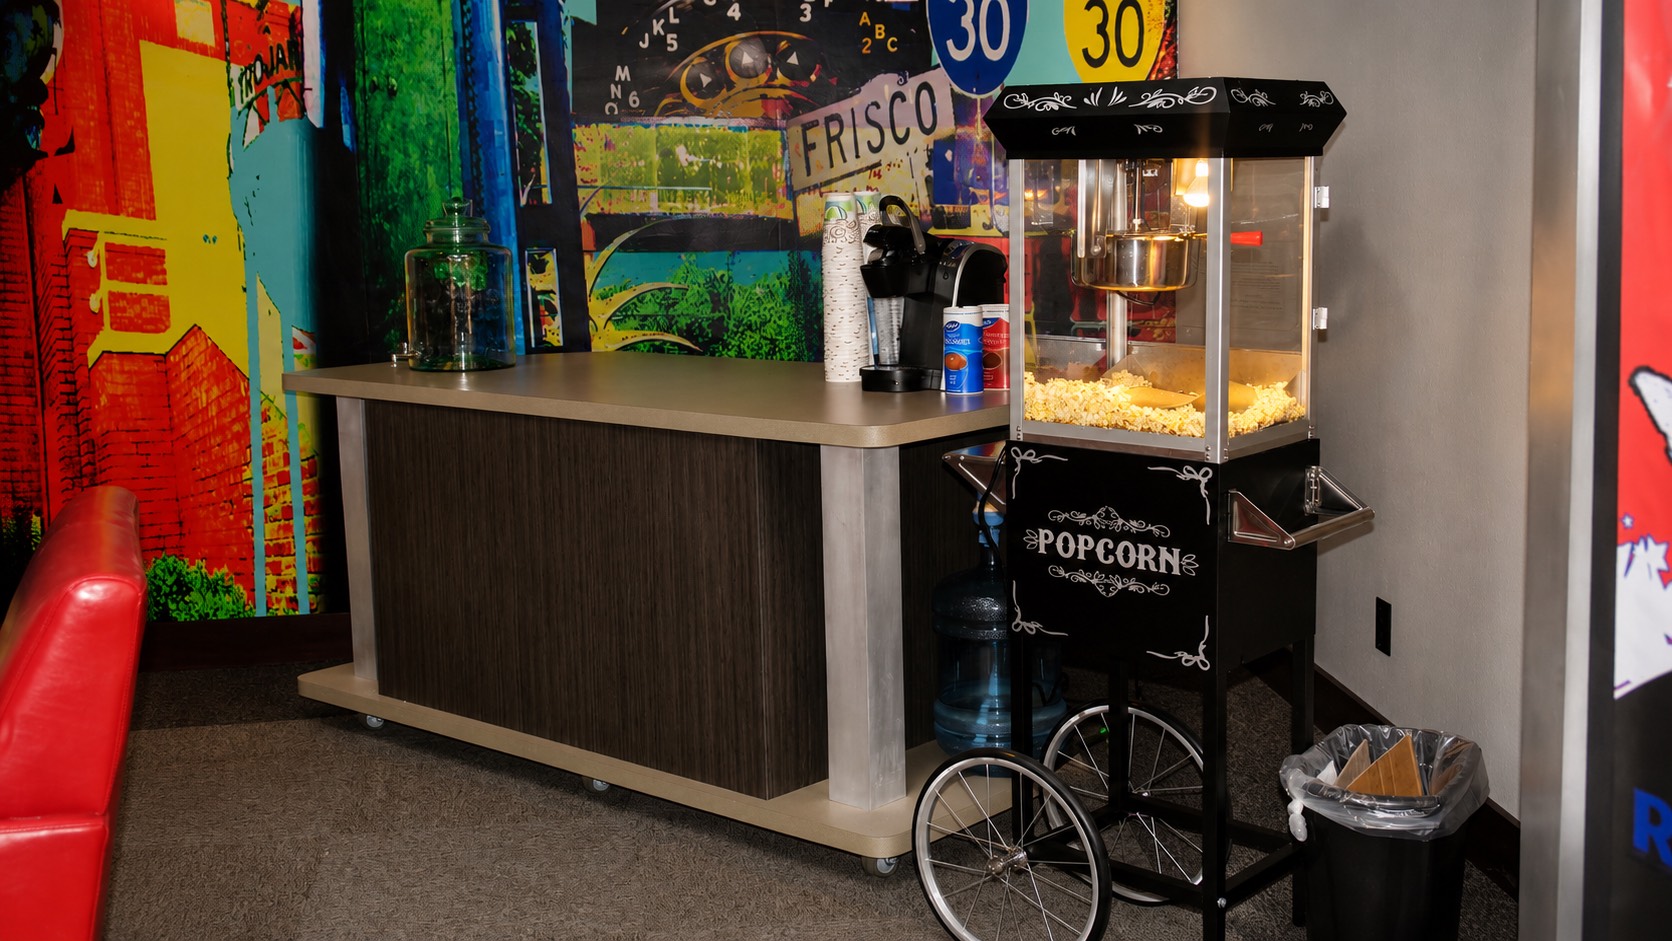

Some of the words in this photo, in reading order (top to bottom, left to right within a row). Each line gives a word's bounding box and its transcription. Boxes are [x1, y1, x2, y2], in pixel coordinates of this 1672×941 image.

[726, 3, 741, 21] 4
[799, 4, 812, 22] 3
[639, 33, 649, 48] J
[652, 18, 665, 36] K
[669, 6, 680, 24] L
[859, 12, 871, 26] A
[875, 24, 886, 39] B
[887, 37, 898, 52] C
[946, 0, 1010, 62] 30
[1082, 0, 1145, 68] 30
[666, 34, 678, 51] 5
[861, 38, 871, 54] 2
[615, 65, 631, 82] M
[610, 84, 622, 99] N
[628, 91, 640, 108] 6
[801, 81, 938, 177] FRISCO
[1037, 528, 1181, 576] POPCORN
